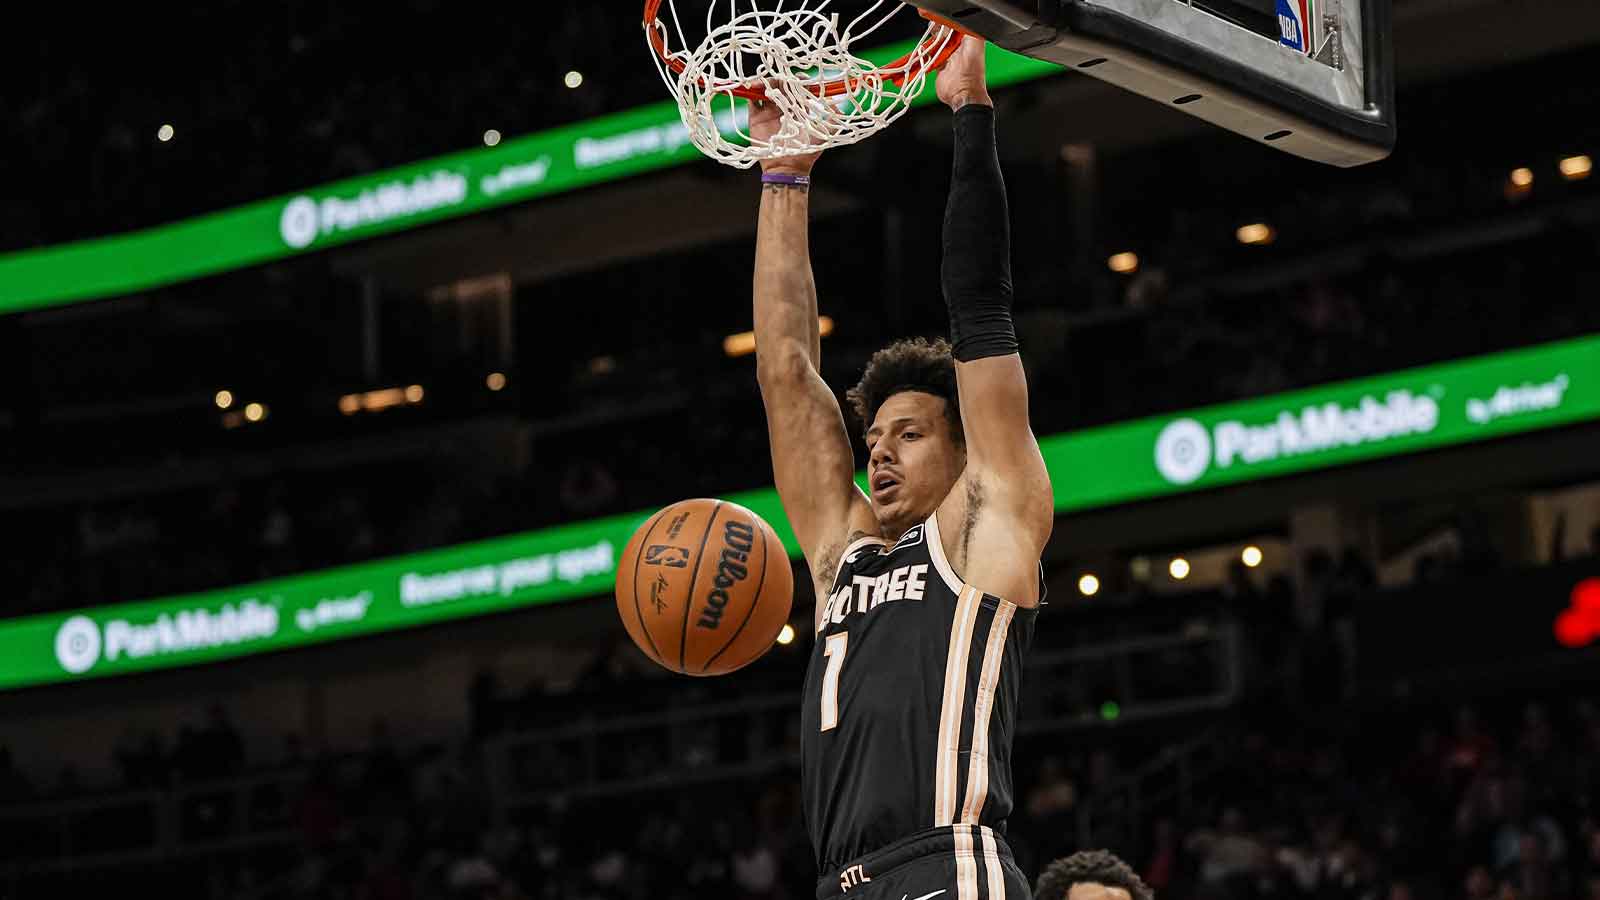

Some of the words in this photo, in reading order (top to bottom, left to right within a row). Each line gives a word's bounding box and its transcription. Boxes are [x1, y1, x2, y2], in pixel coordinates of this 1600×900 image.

[1279, 14, 1299, 44] NBA
[1214, 389, 1438, 468] ParkMobile
[696, 520, 753, 630] Wilson
[104, 598, 279, 661] ParkMobile
[820, 631, 848, 732] 1
[840, 864, 871, 893] ATL
